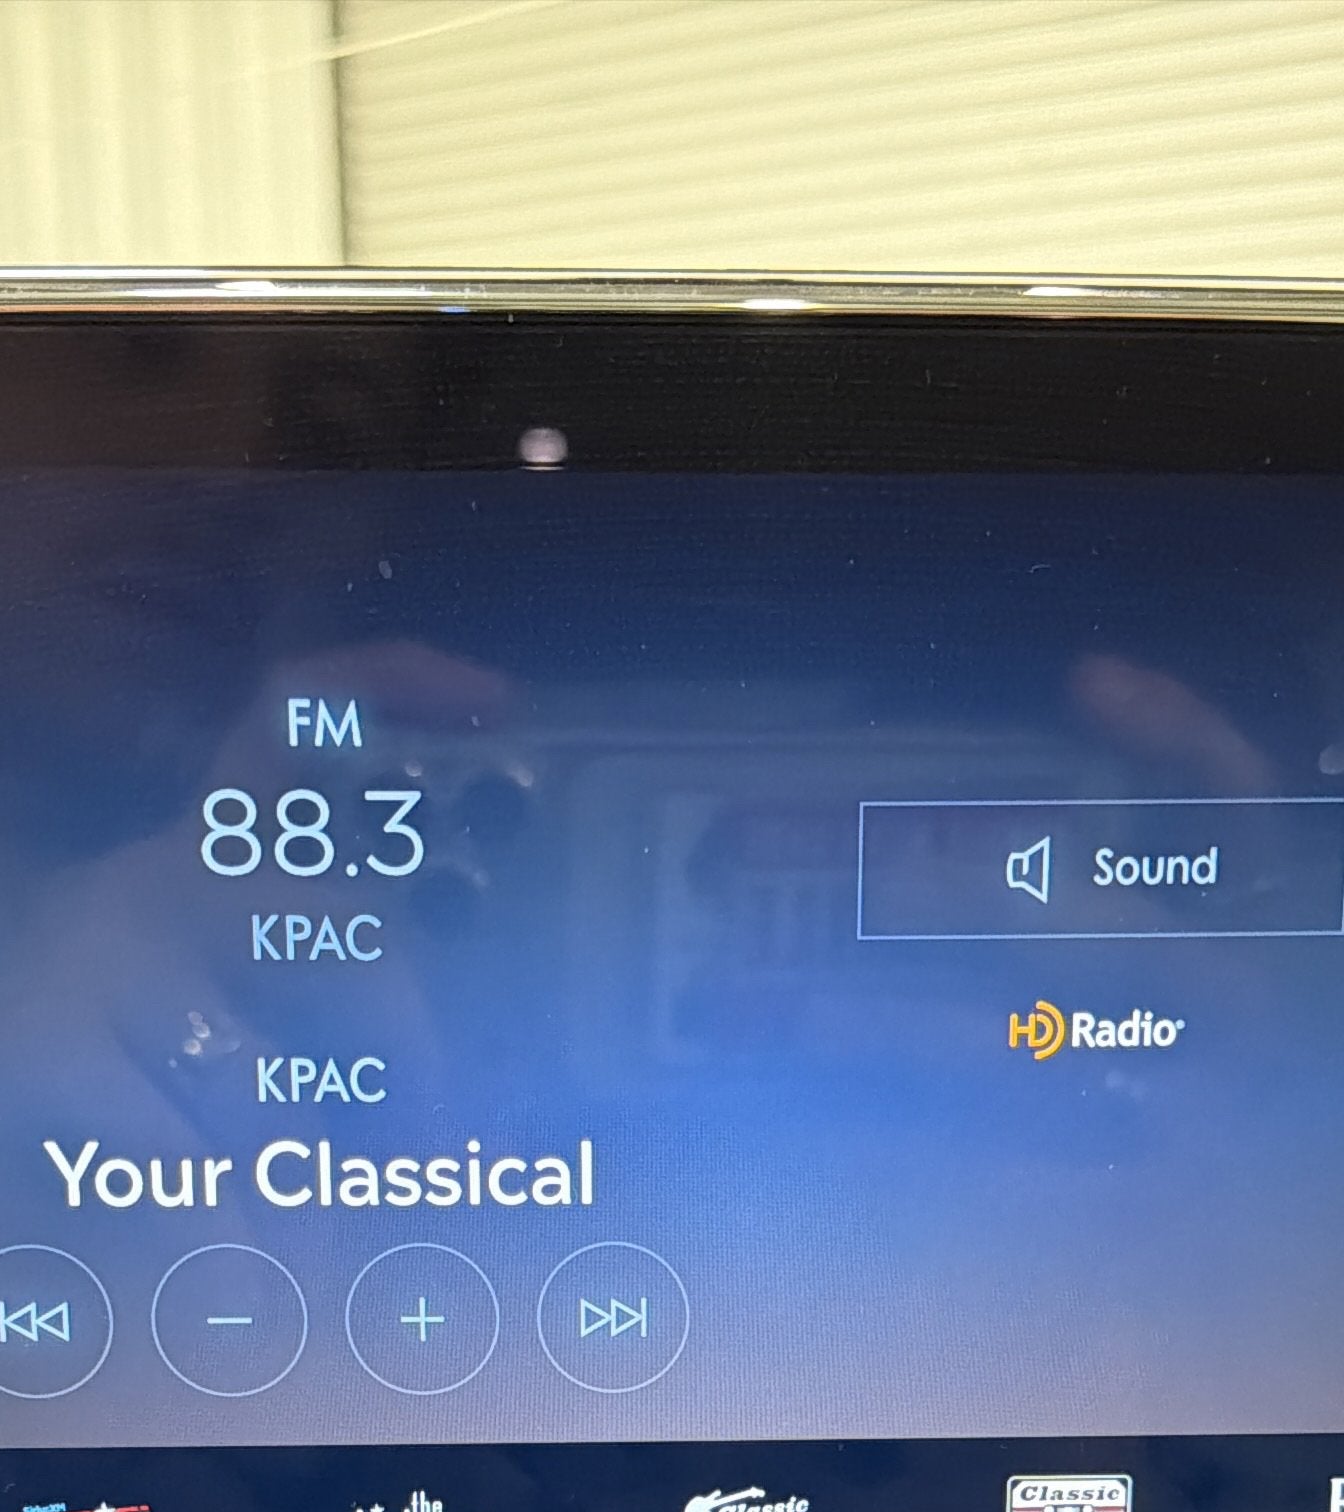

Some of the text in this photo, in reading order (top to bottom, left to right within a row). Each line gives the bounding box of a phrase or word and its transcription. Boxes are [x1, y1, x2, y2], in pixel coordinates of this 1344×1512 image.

[287, 698, 363, 748] FM
[200, 788, 424, 877] 88.3
[1093, 846, 1218, 886] Sound
[251, 914, 383, 962] KPAC
[1071, 1008, 1177, 1047] Radio
[257, 1056, 387, 1103] KPAC
[43, 1139, 593, 1208] Your Classical
[1020, 1485, 1120, 1502] Classic
